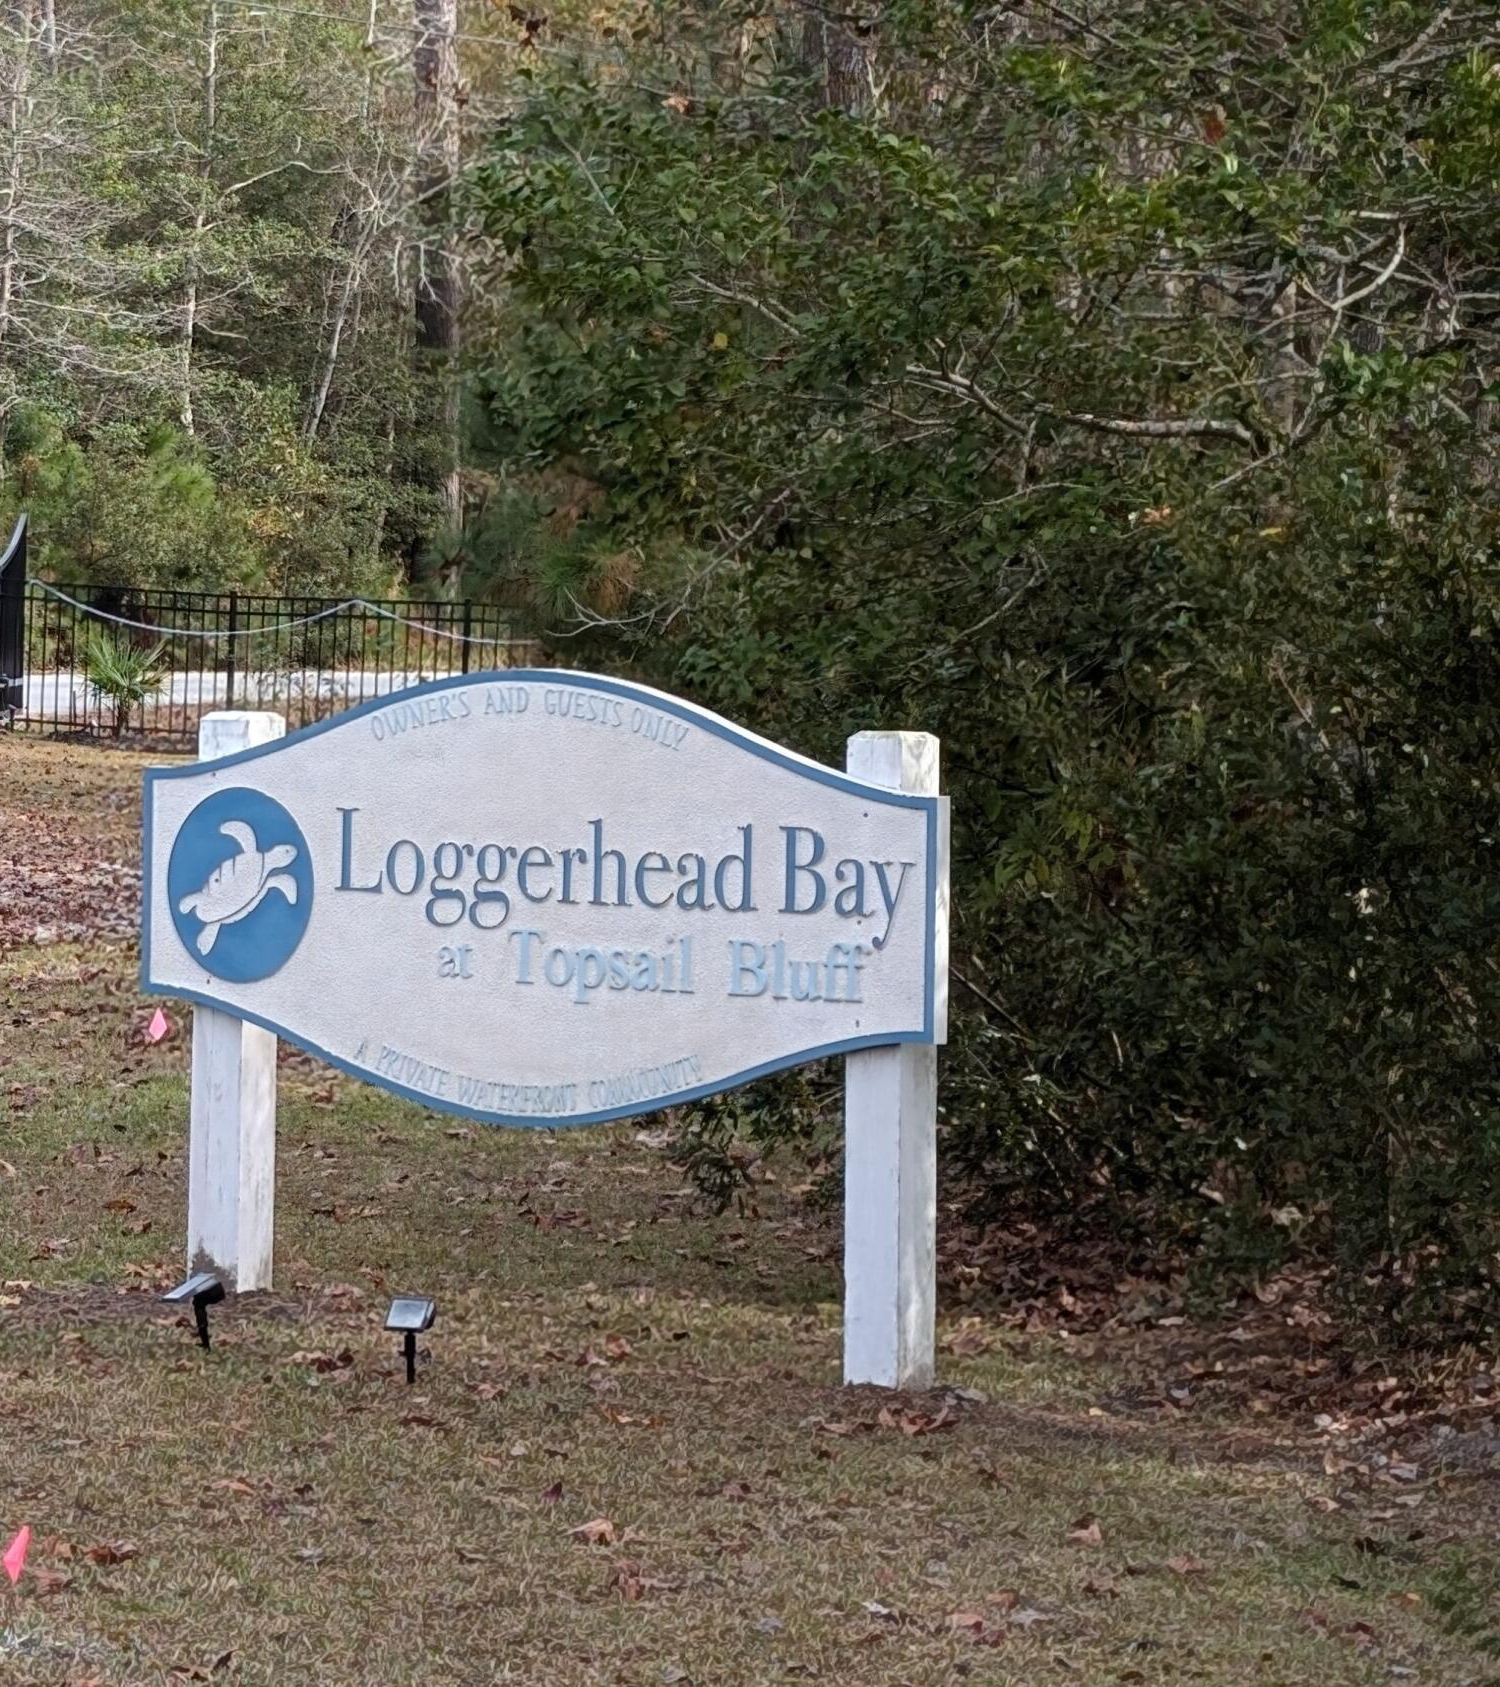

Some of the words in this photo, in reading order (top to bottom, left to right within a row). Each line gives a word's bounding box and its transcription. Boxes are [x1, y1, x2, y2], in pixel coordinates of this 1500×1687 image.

[371, 691, 471, 742] OWNER'S
[483, 686, 530, 716] AND
[543, 688, 624, 728] GUESTS
[630, 707, 690, 752] ONLY
[333, 806, 759, 930] Loggerhead
[777, 825, 917, 951] Bay
[436, 942, 475, 980] at
[507, 928, 695, 1005] Topsail
[727, 939, 873, 1004] Bluff
[353, 1040, 367, 1064] A
[374, 1044, 450, 1097] PRIVATE
[456, 1074, 578, 1114] WATERFRONT
[588, 1053, 704, 1110] COMMUNITY
